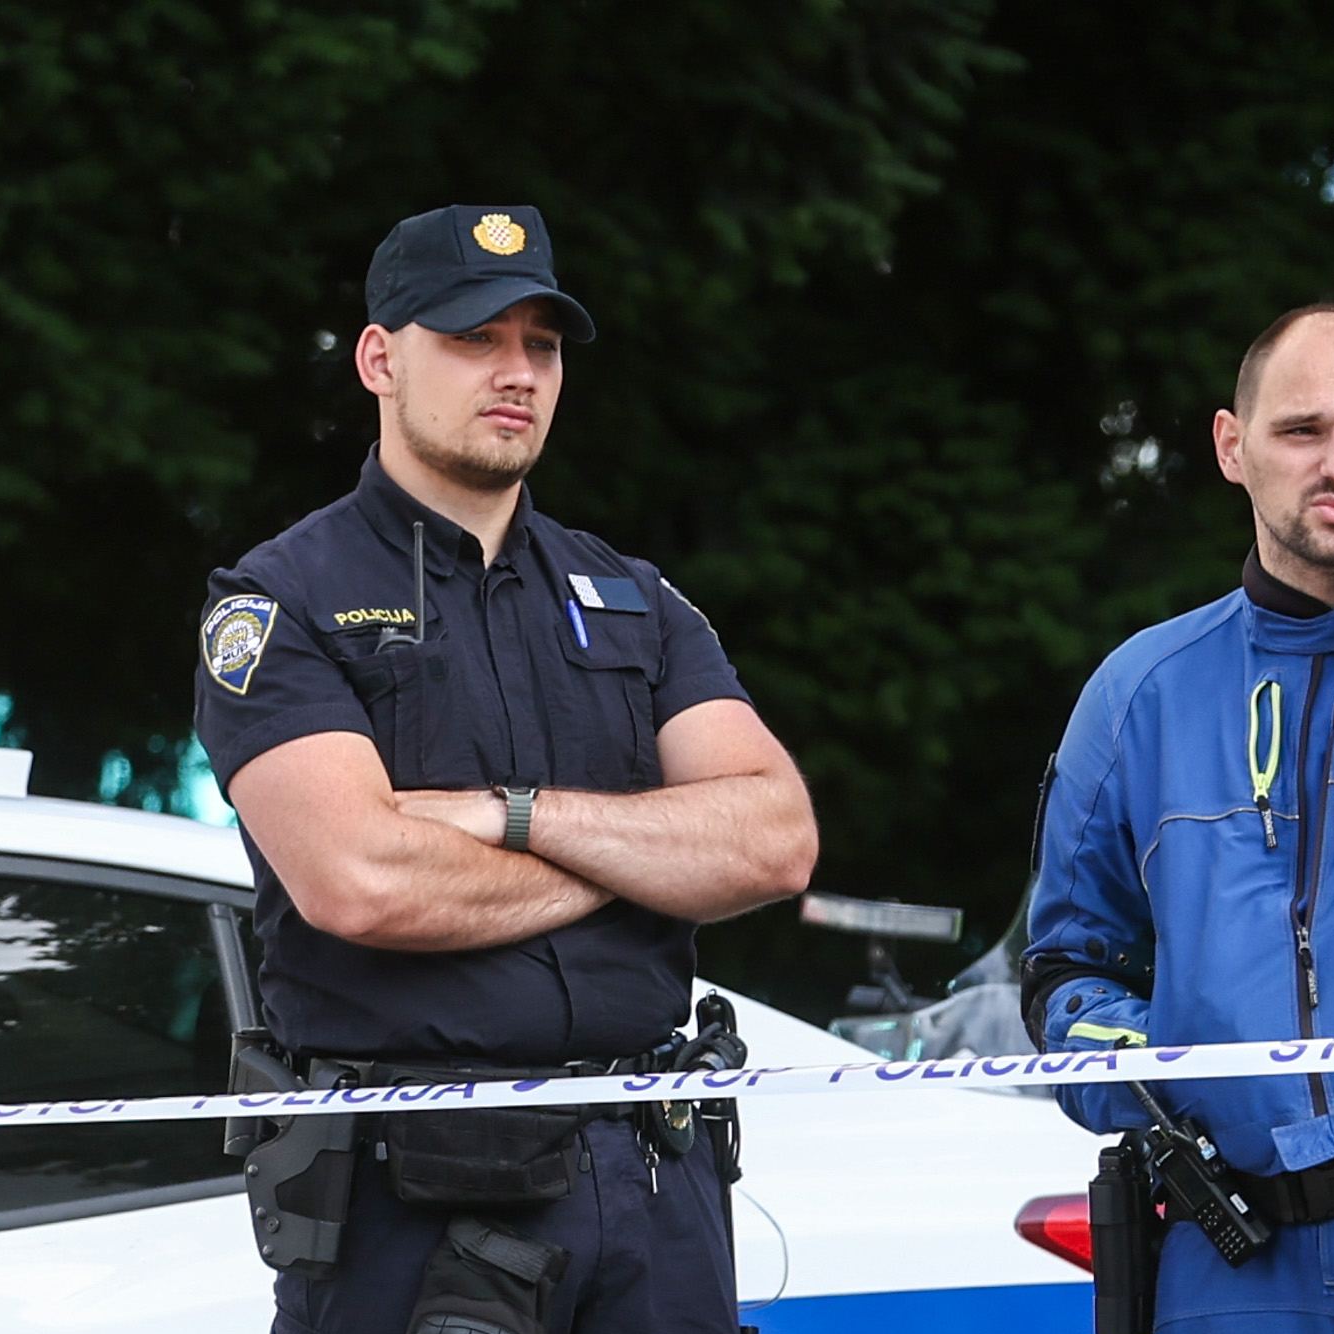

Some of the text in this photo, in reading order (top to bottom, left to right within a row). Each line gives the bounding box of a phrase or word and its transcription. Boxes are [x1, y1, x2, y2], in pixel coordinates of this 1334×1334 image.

[206, 598, 272, 635] POLICIJA
[333, 608, 416, 626] POLICIJA
[222, 644, 248, 661] MUP
